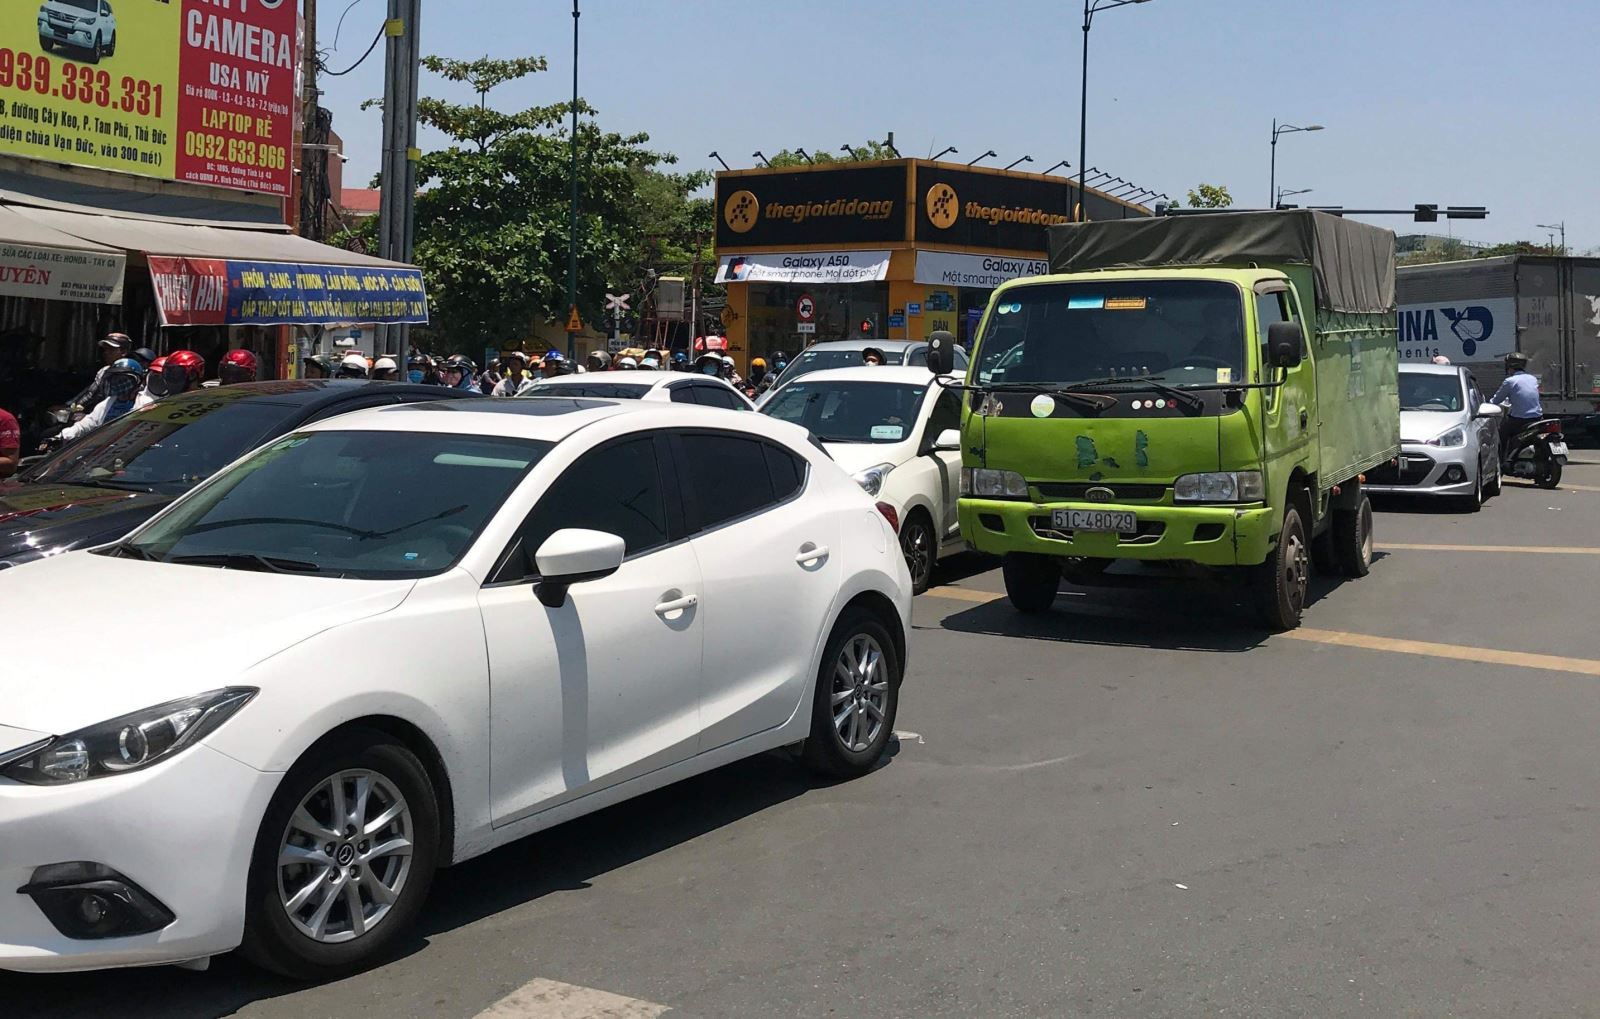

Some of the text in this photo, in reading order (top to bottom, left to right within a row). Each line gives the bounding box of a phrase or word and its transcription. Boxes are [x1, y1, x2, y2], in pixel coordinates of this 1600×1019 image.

[187, 9, 291, 69] CAMERA
[209, 62, 269, 95] USA MỸ
[12, 101, 38, 123] đường
[61, 111, 80, 131] Keo,
[83, 115, 91, 131] P.
[95, 117, 111, 135] Tam
[152, 128, 167, 145] Đức
[202, 107, 272, 138] LAPTOP RẺ
[0, 125, 162, 167] diện chùa Vạn Đức, vào 300 mét)
[185, 131, 285, 169] 0932.633.966
[765, 199, 893, 224] thegioididong
[64, 254, 88, 265] HONDA
[782, 255, 850, 270] Galaxy A50
[982, 258, 1047, 276] Galaxy A50
[195, 264, 224, 311] HÀN
[269, 272, 292, 289] GANG
[942, 271, 961, 286] Một
